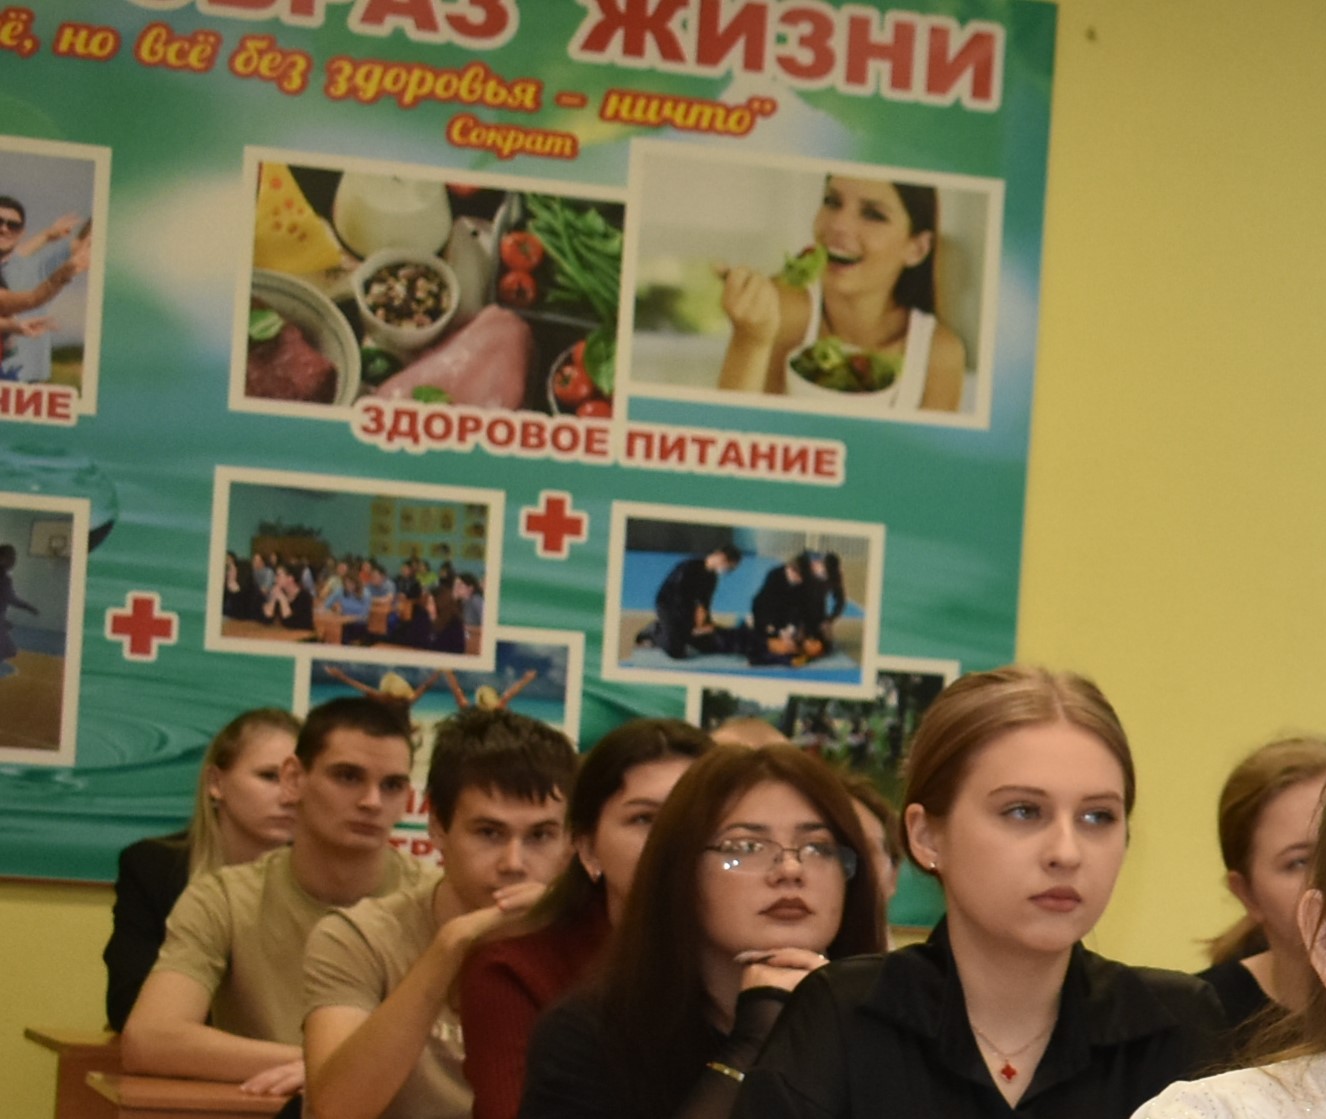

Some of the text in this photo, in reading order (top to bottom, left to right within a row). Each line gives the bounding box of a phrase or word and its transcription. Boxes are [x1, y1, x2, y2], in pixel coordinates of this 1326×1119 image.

[56, 24, 117, 59] но
[137, 23, 216, 70] всё
[231, 38, 308, 91] без
[328, 60, 538, 107] здоровья
[578, 0, 998, 102] ЖИЗНИ
[449, 115, 576, 157] Сократ
[360, 404, 839, 478] ЗДОРОВОЕ ПИТАНИЕ
